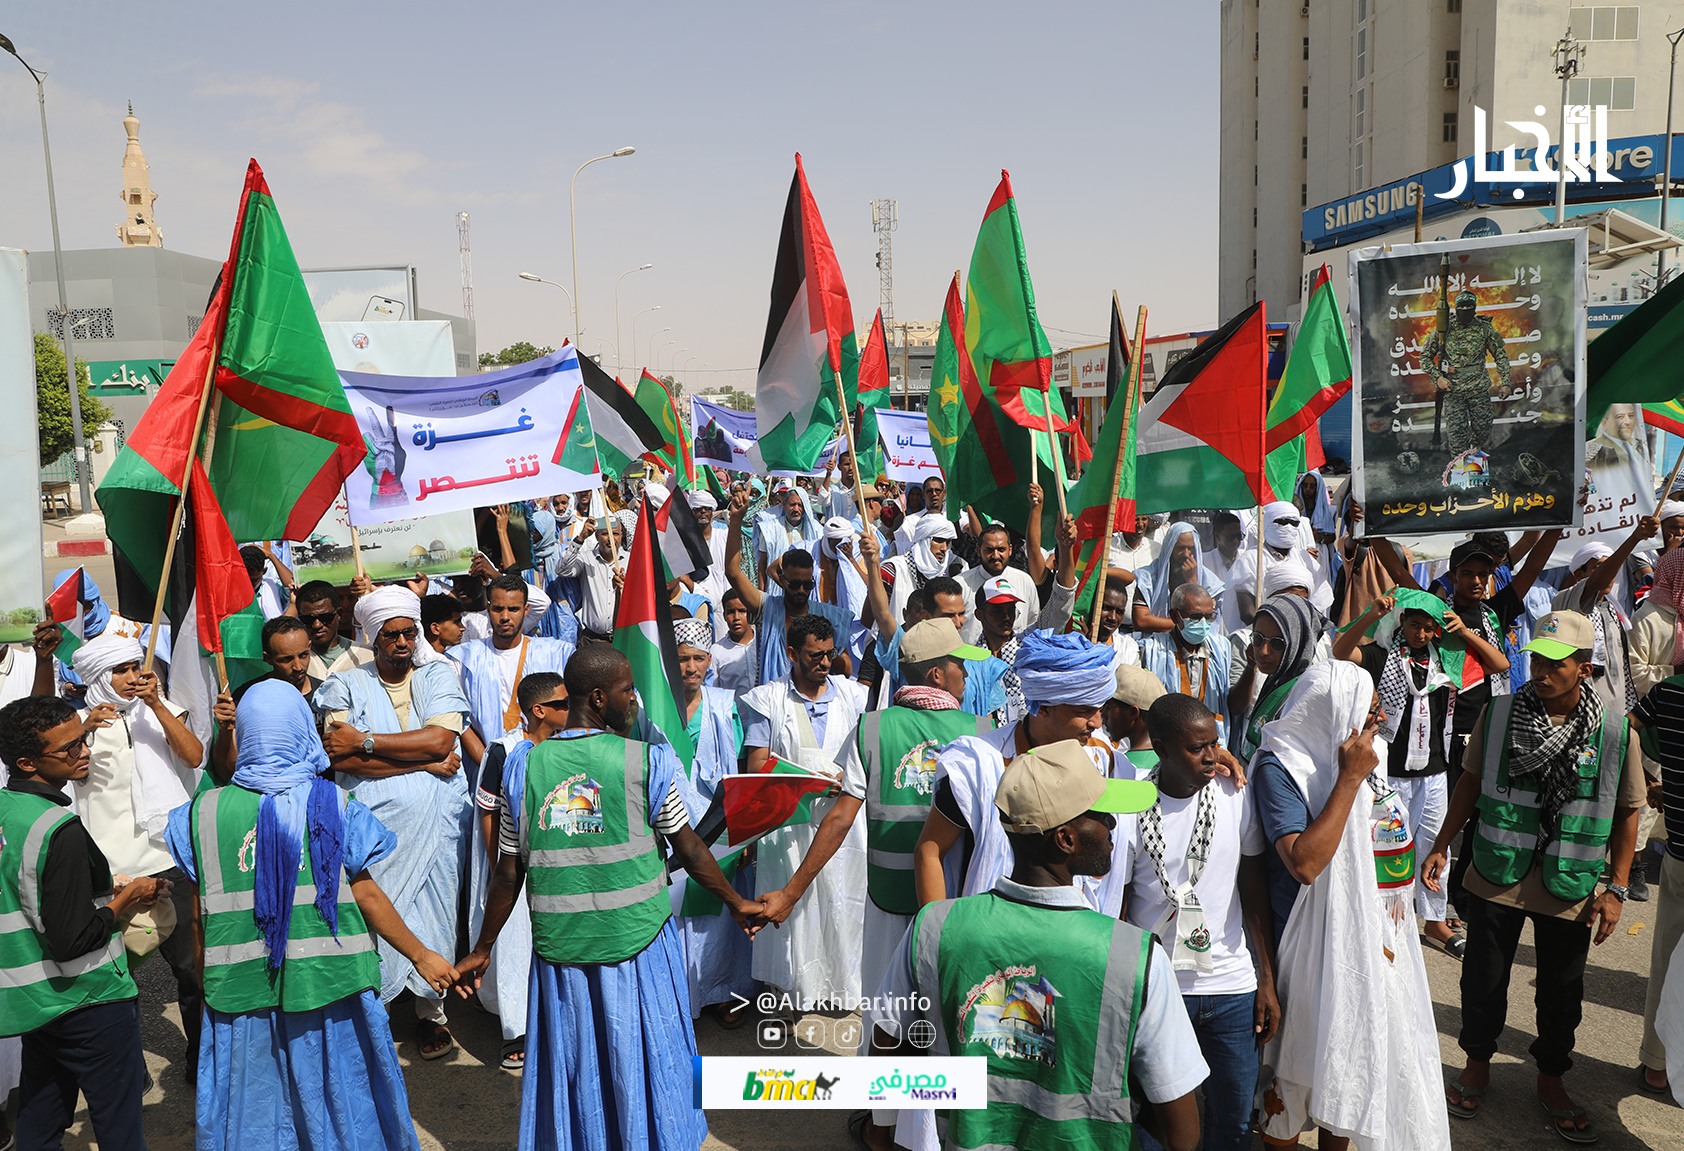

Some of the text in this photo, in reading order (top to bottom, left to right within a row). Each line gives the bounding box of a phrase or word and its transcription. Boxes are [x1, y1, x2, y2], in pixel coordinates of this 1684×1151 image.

[1324, 181, 1422, 230] SAMSUNG
[412, 407, 536, 451] غزة
[415, 453, 541, 502] تنتصر
[1429, 488, 1509, 518] الأحزاب
[1619, 493, 1638, 513] لم
